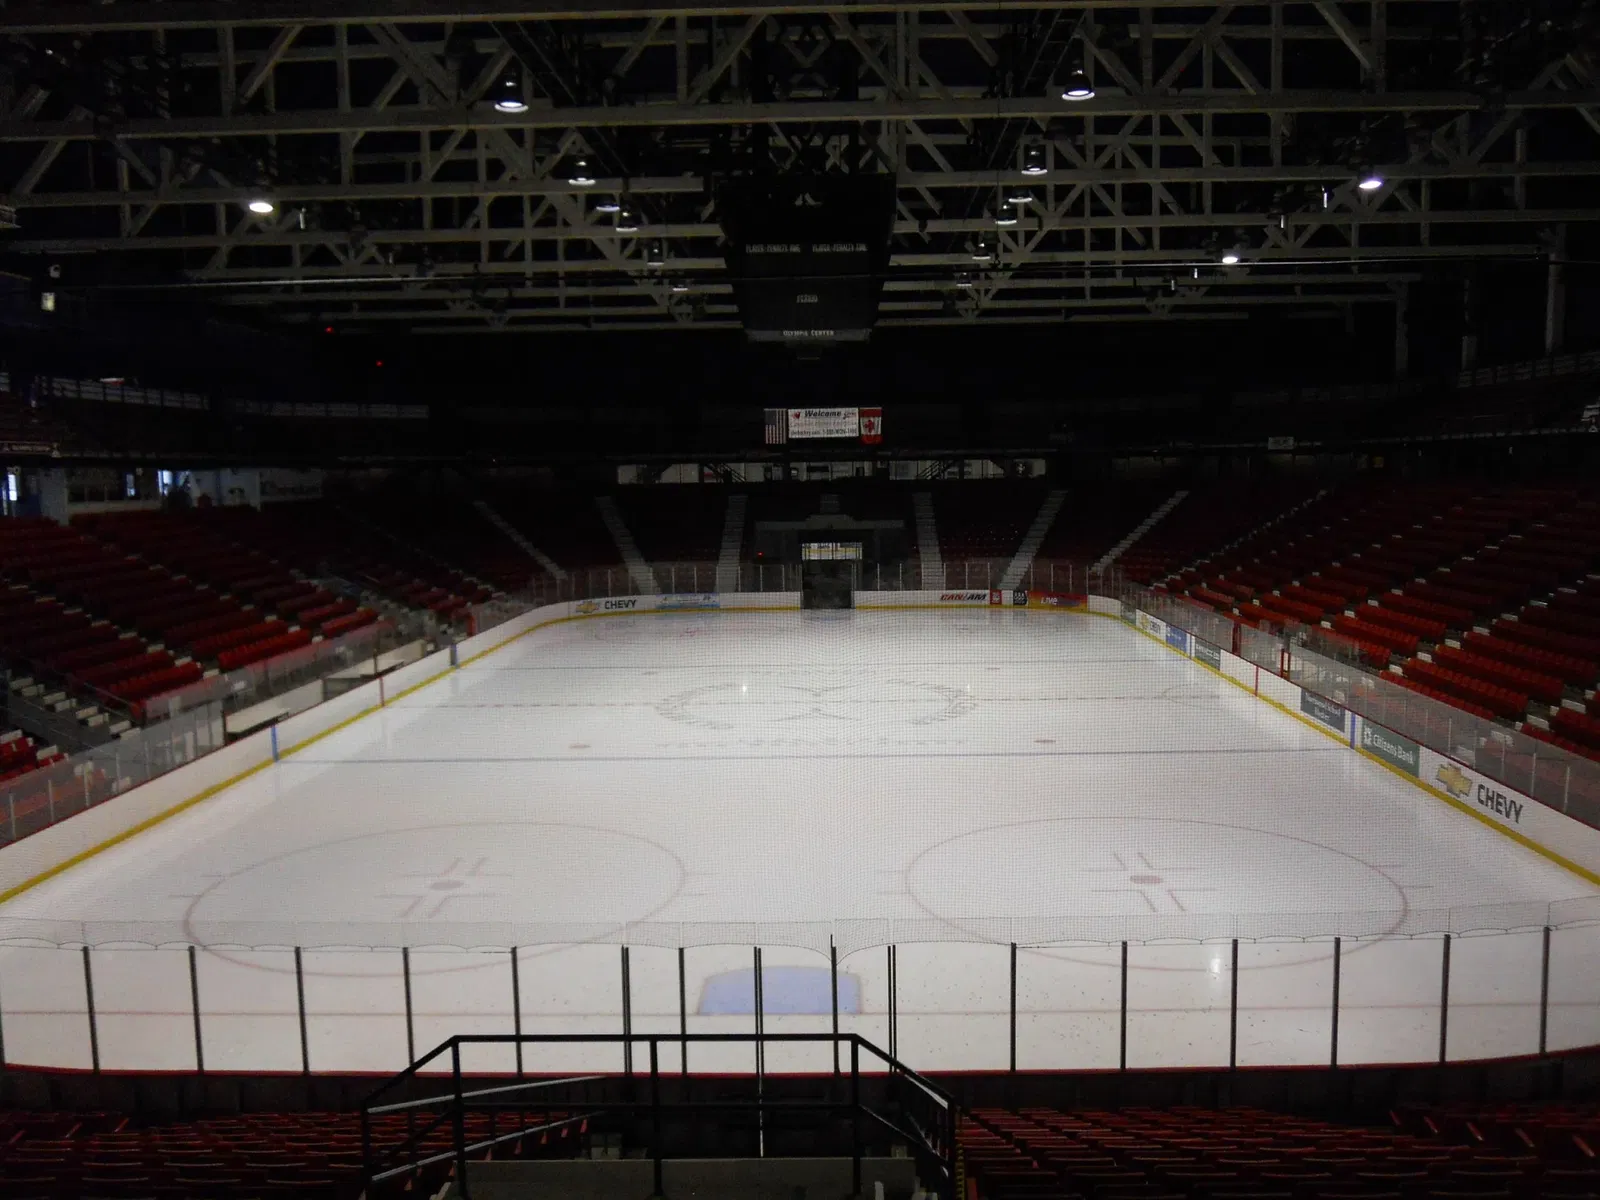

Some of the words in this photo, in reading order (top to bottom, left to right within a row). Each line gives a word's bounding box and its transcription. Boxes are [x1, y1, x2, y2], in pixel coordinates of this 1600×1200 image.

[810, 329, 834, 337] CENTER
[804, 410, 842, 418] Welcome
[604, 599, 637, 610] CHEVY
[1373, 734, 1398, 758] Citizens
[1397, 745, 1415, 766] Bank
[1477, 784, 1524, 824] CHEVY
